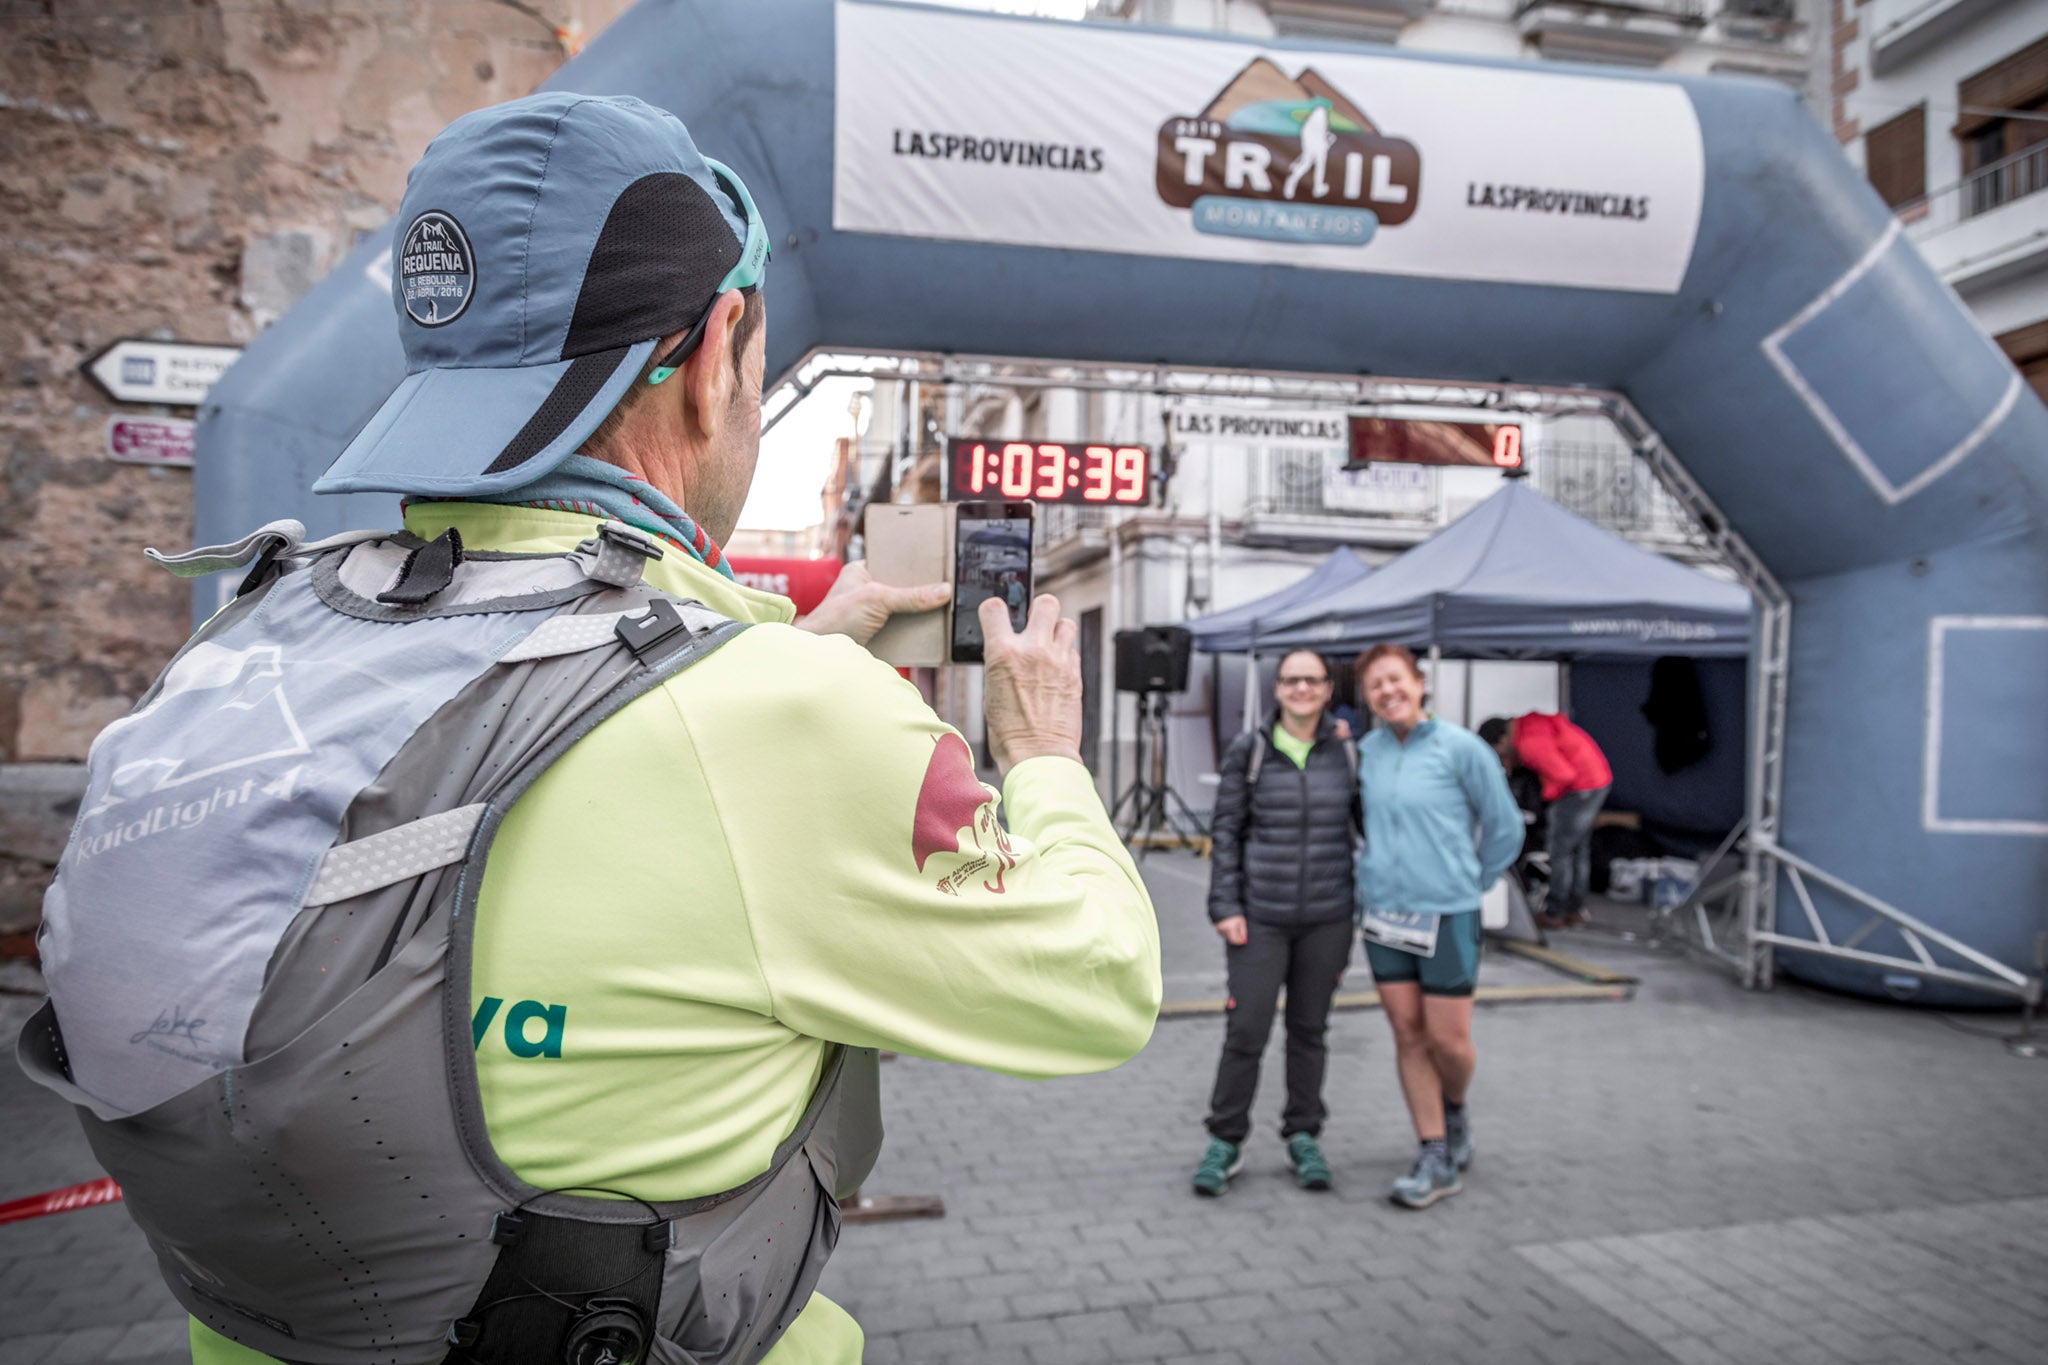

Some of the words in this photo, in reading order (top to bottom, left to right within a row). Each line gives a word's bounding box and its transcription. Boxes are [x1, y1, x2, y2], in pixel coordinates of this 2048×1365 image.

[893, 129, 1104, 173] LASPROVINCIAS
[1467, 181, 1650, 221] LASPROVINCIAS
[1203, 204, 1364, 236] MONTANEJOS
[423, 240, 445, 252] TRAIL
[403, 252, 465, 275] REQUENA
[407, 287, 464, 300] 22/ABRIL/2018
[409, 278, 417, 287] EL
[417, 275, 457, 286] REBOLLAR
[1176, 413, 1214, 433] LAS
[1219, 415, 1342, 440] PROVINCIAS
[971, 443, 1145, 502] 1:03:39
[1571, 617, 1717, 642] www.mychip.es
[76, 778, 256, 866] RaidLight
